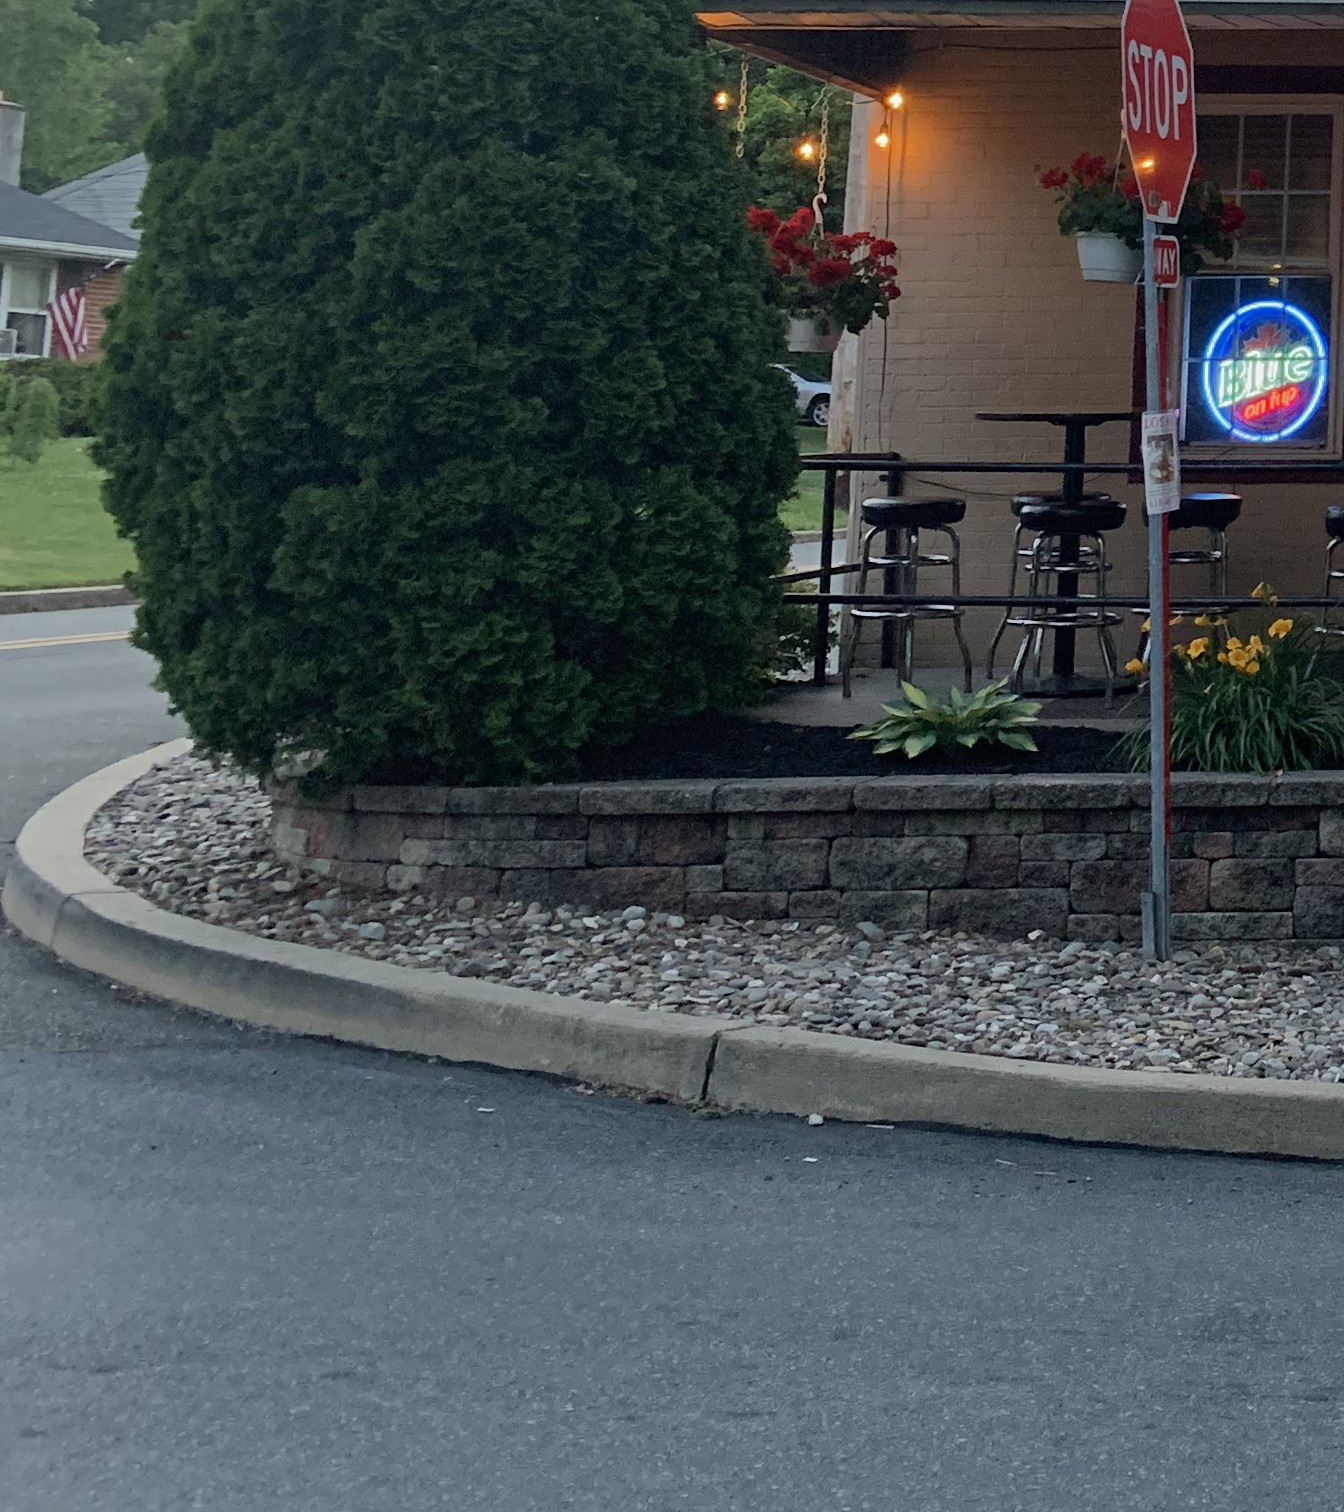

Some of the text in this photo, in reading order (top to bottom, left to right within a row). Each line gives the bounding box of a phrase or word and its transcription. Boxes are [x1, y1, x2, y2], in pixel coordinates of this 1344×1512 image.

[1128, 39, 1188, 140] STOP
[1218, 345, 1313, 408] Blue
[1244, 398, 1267, 420] on
